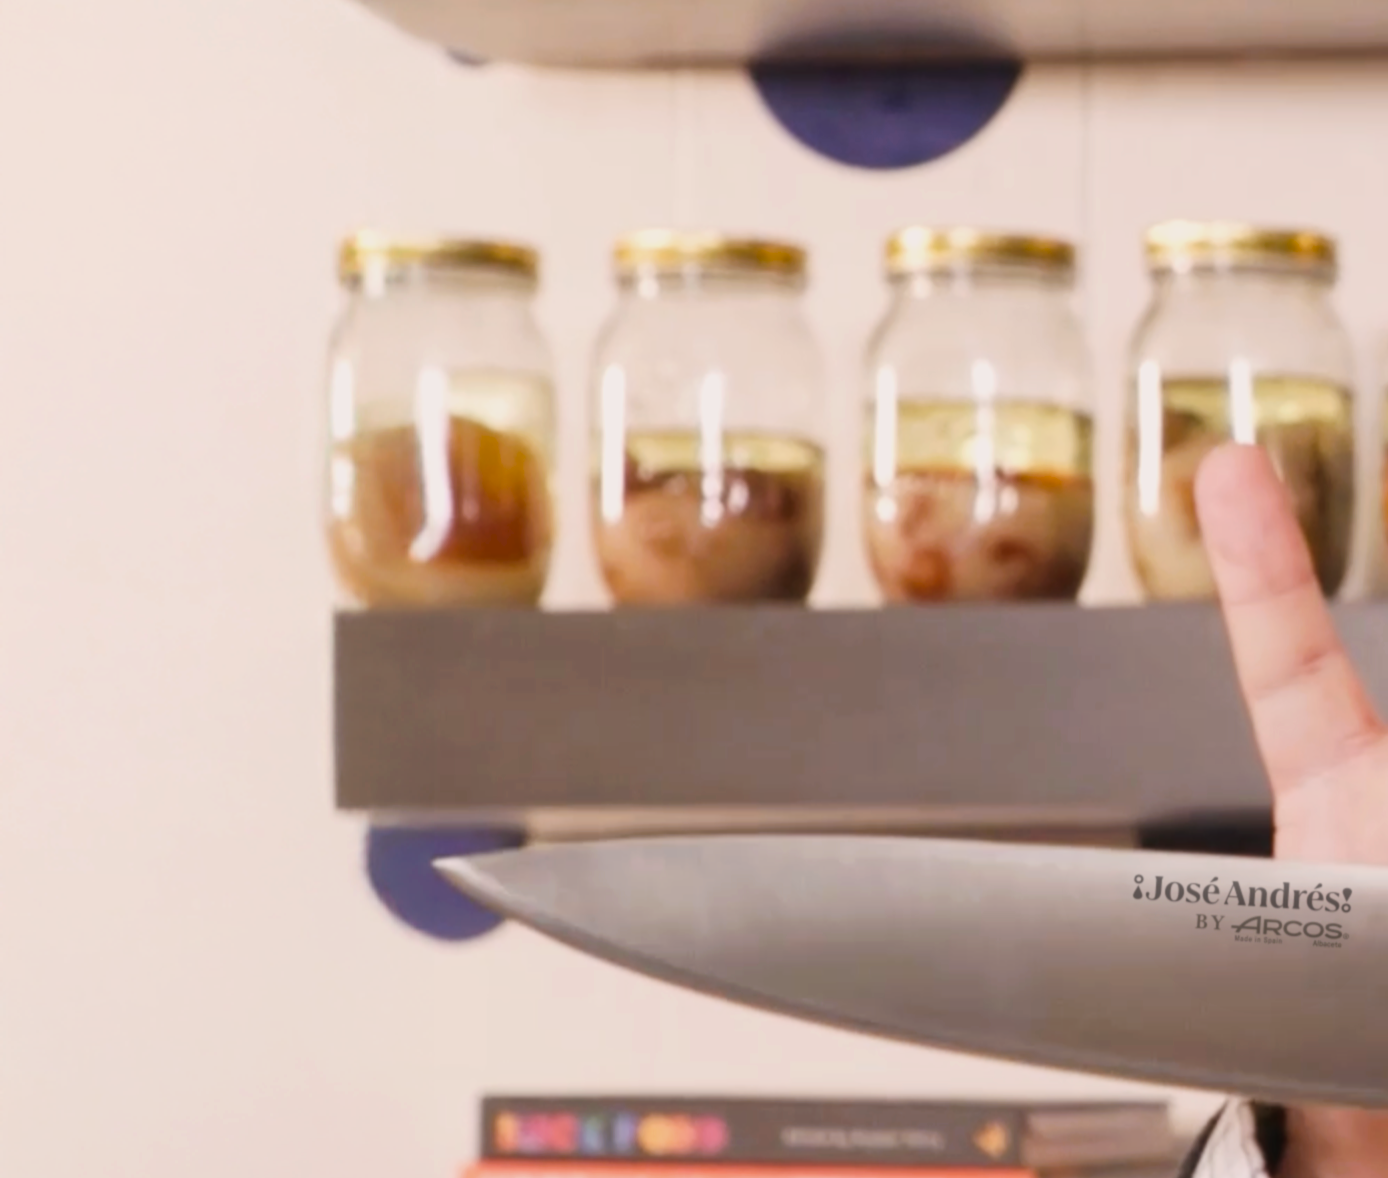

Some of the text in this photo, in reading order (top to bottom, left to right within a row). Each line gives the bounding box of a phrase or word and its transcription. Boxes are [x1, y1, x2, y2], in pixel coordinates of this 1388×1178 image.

[1195, 914, 1343, 940] BY ARCOS
[1234, 934, 1283, 945] Made in Spain
[1312, 939, 1342, 949] Albacete
